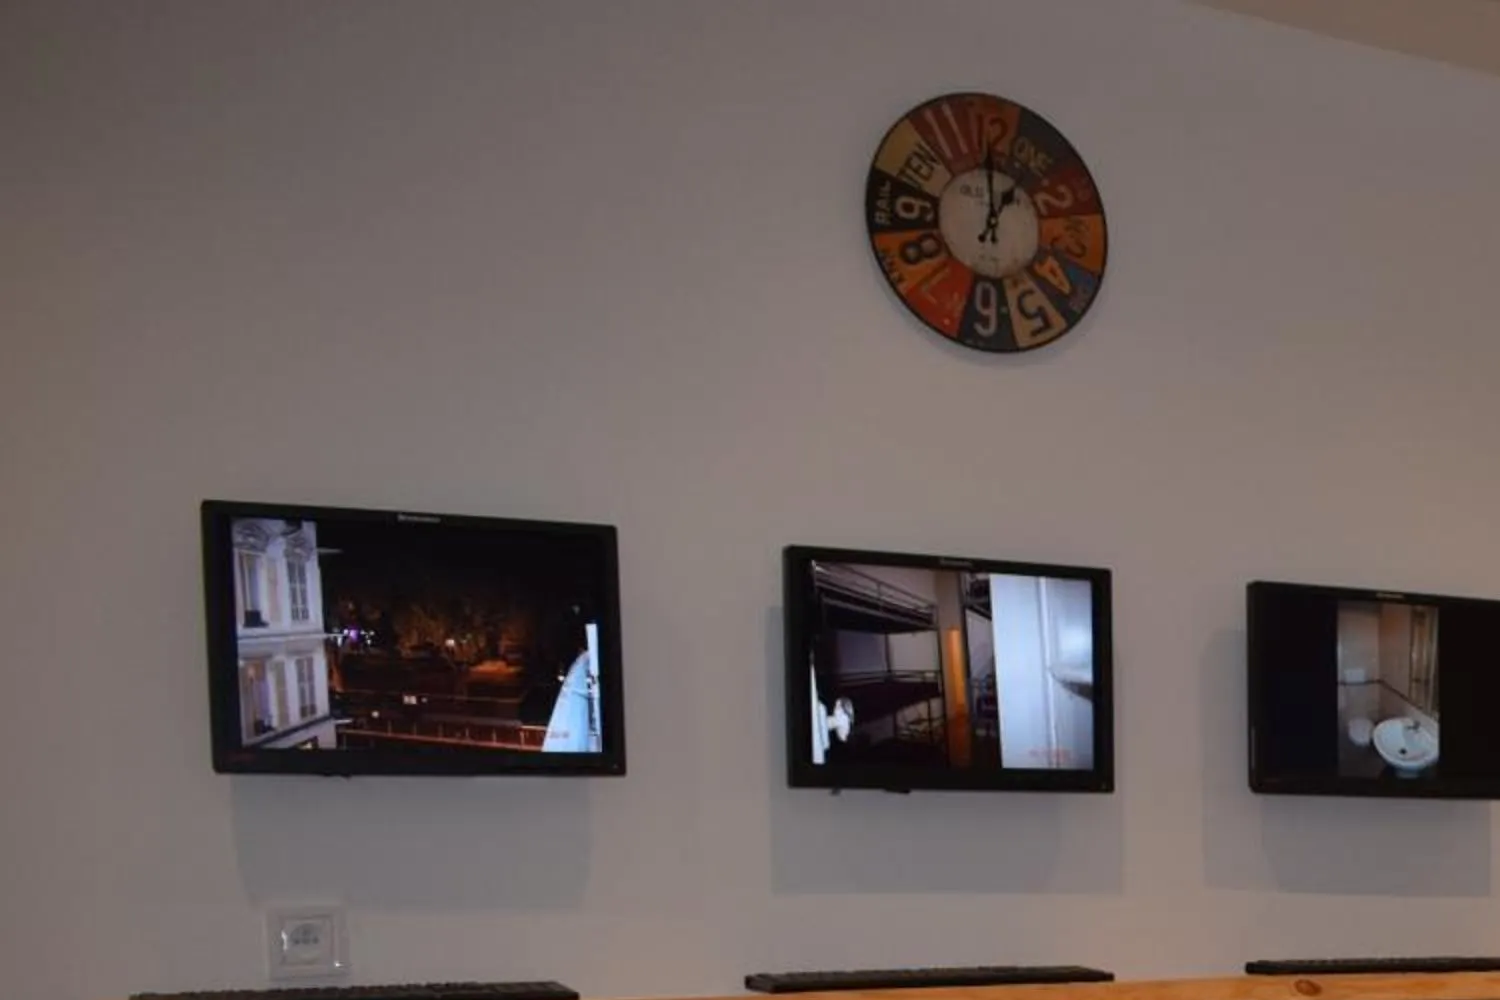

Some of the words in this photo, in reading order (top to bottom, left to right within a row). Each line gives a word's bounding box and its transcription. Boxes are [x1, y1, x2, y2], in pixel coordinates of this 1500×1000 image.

[897, 141, 944, 188] TEN
[893, 195, 936, 224] 9
[1034, 185, 1075, 216] 2
[901, 233, 943, 265] 8
